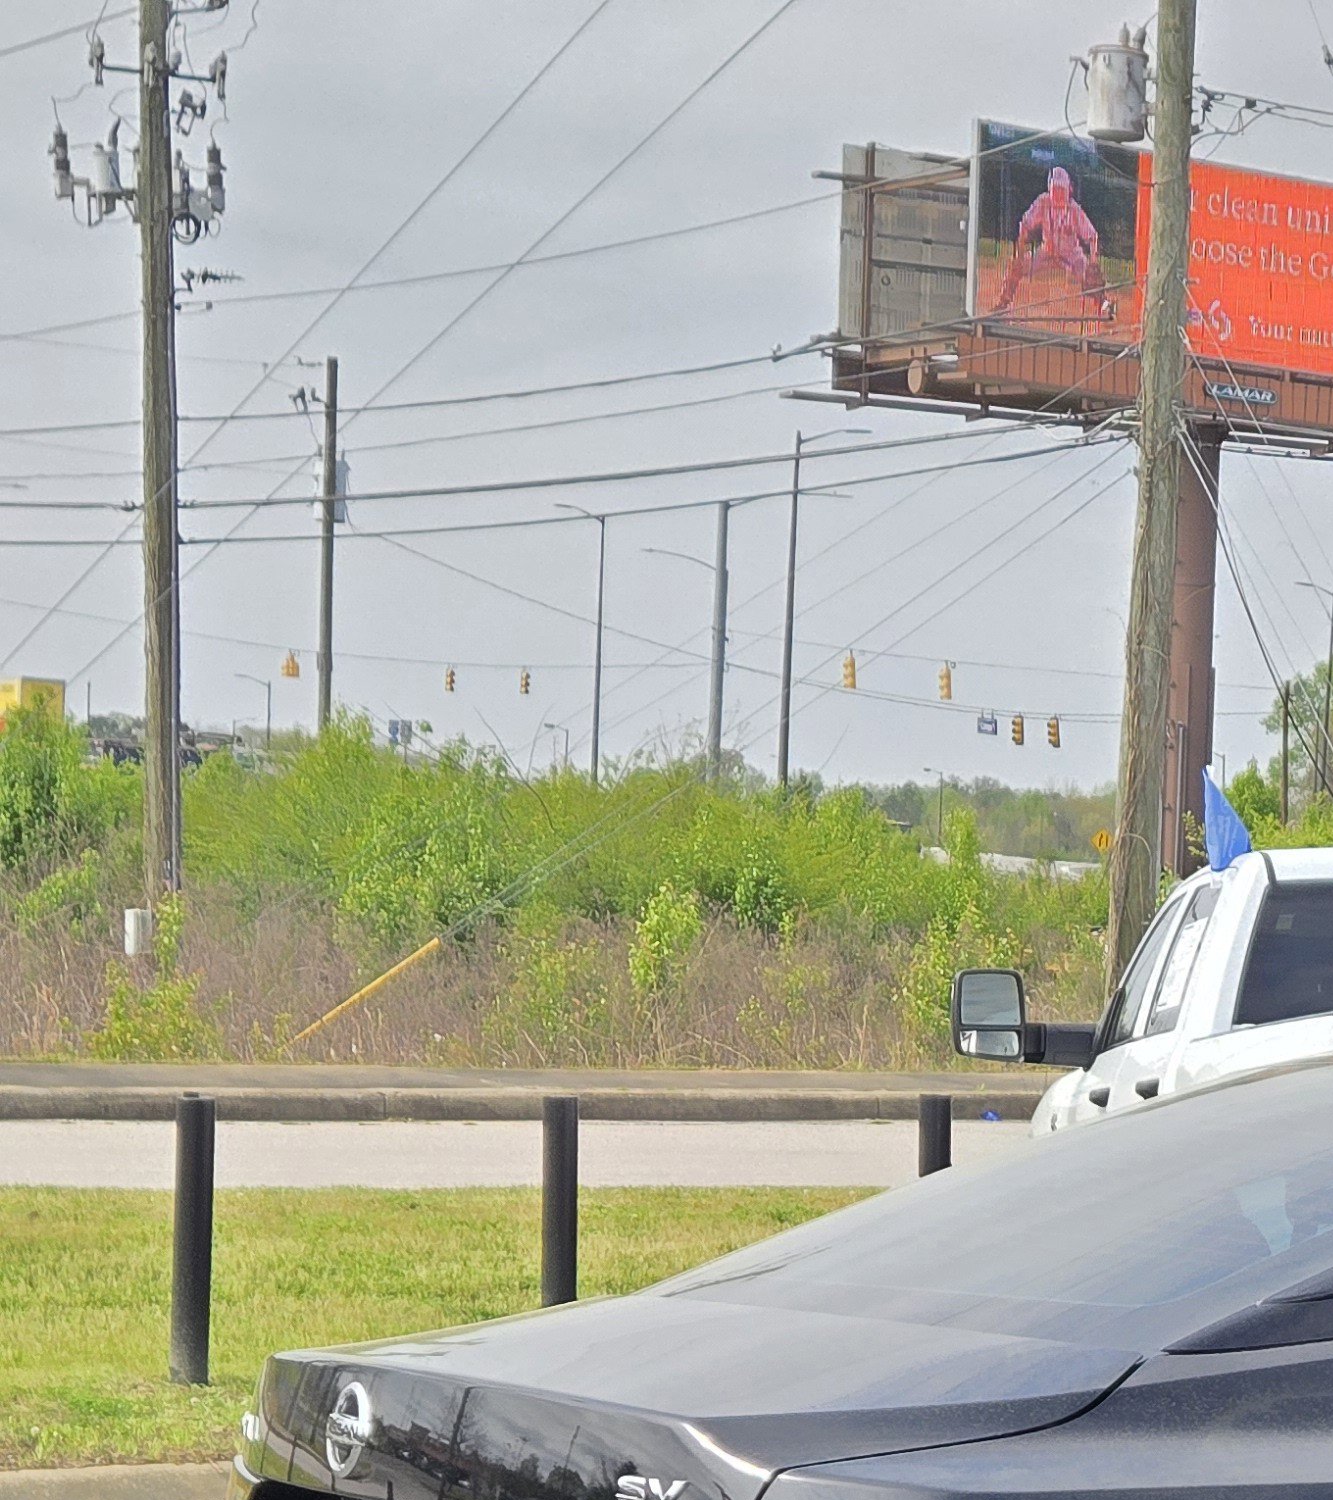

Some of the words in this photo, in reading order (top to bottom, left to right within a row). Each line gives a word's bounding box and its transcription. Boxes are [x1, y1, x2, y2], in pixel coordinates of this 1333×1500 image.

[1207, 184, 1278, 226] clean
[1190, 237, 1253, 268] oose
[1260, 241, 1303, 276] the
[1249, 314, 1294, 342] Your
[1212, 383, 1274, 401] LAMAR
